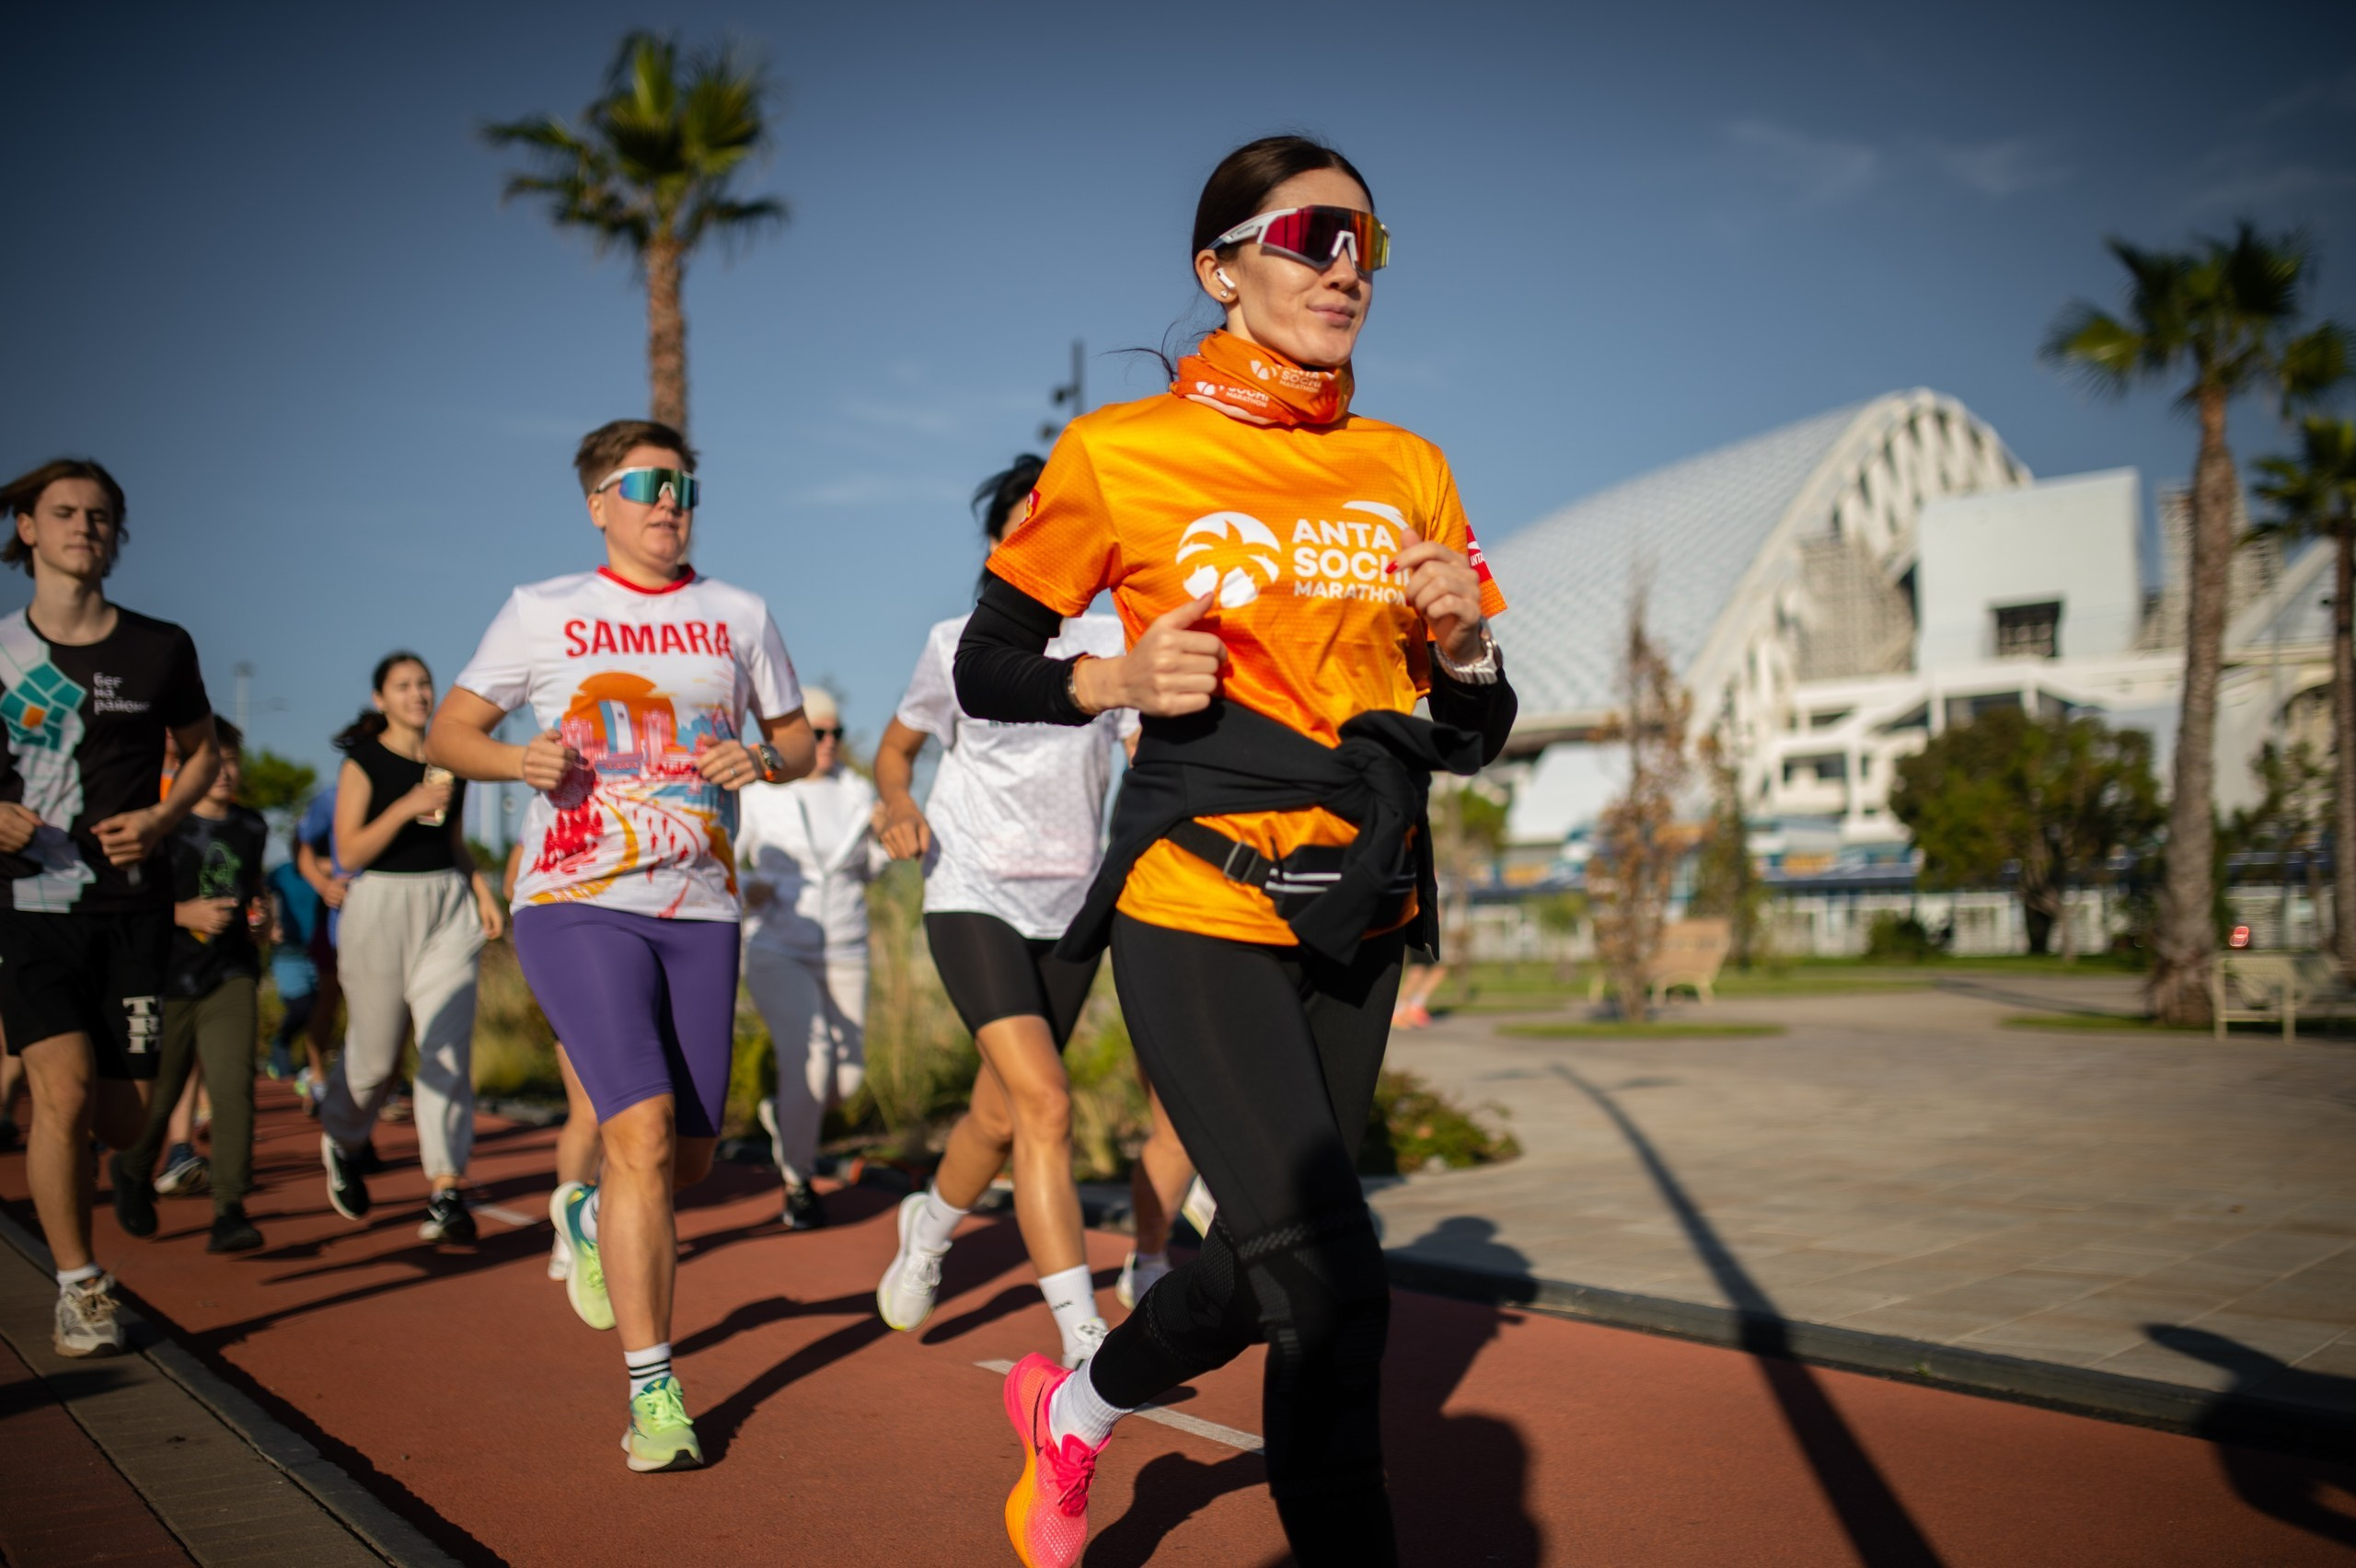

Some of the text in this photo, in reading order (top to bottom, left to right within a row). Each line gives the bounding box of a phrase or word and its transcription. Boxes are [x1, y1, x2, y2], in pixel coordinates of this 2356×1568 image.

[1281, 370, 1322, 387] SOCHI
[1226, 391, 1267, 408] MARATHON
[1291, 518, 1398, 552] ANTA
[1293, 547, 1411, 587] SOCHI
[1294, 580, 1406, 606] MARATHON
[564, 618, 733, 661] SAMARA
